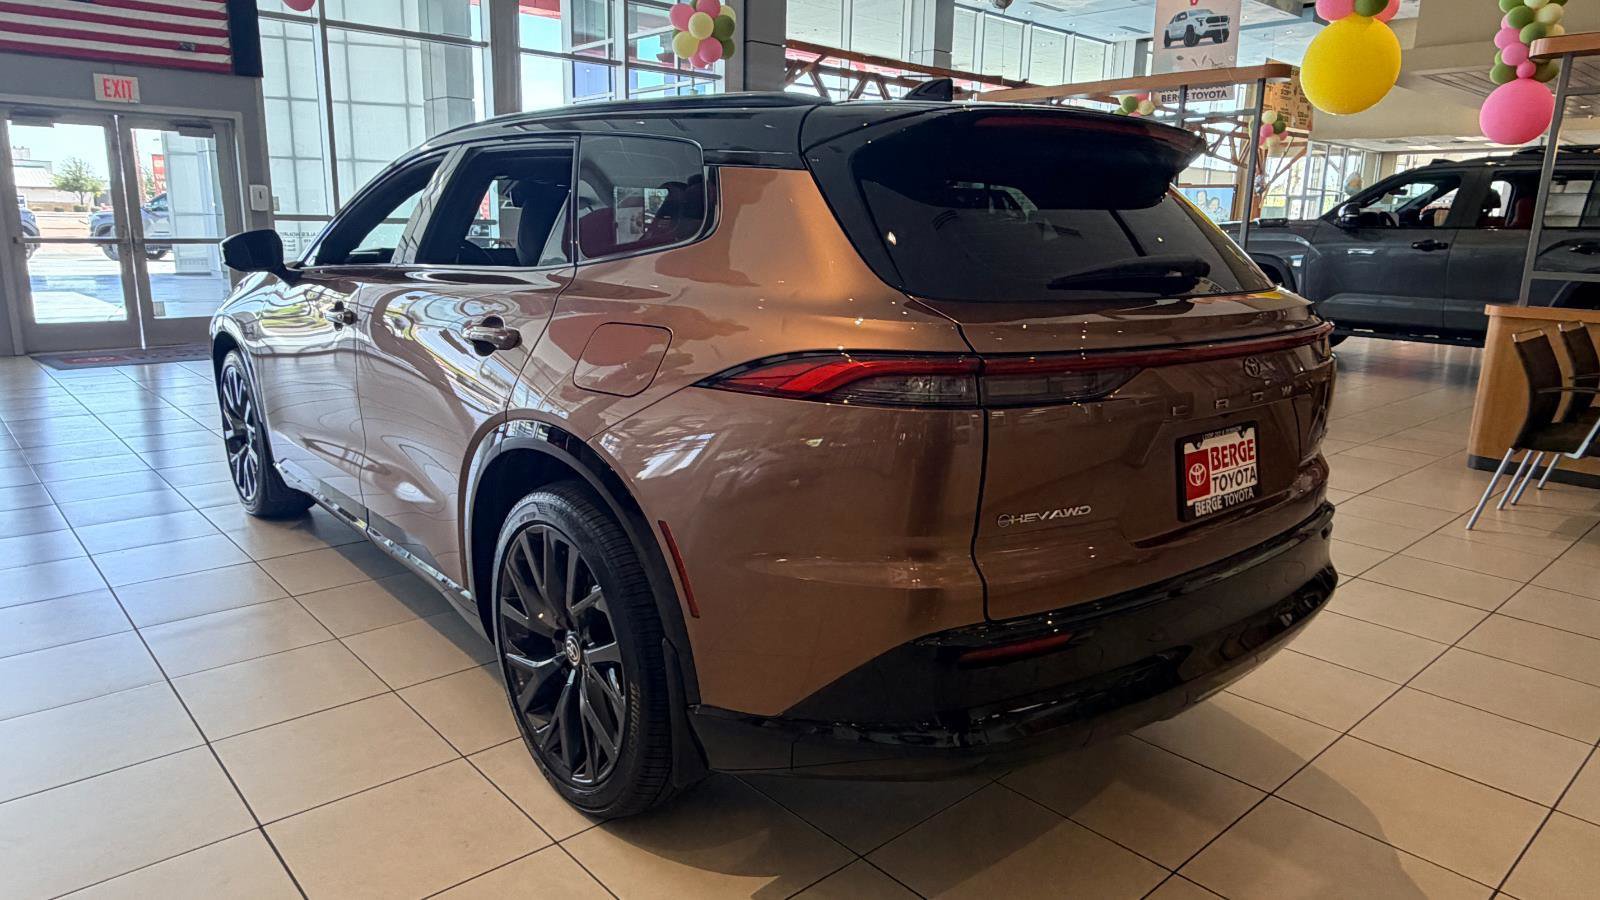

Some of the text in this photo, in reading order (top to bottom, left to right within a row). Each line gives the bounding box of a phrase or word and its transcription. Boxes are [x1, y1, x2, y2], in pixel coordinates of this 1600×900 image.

[103, 79, 132, 100] EXIT
[1191, 90, 1227, 100] TOYOTA
[1210, 438, 1254, 471] BERGE
[1212, 466, 1257, 493] TOYOTA
[1194, 486, 1255, 517] BERGE TOYOTA
